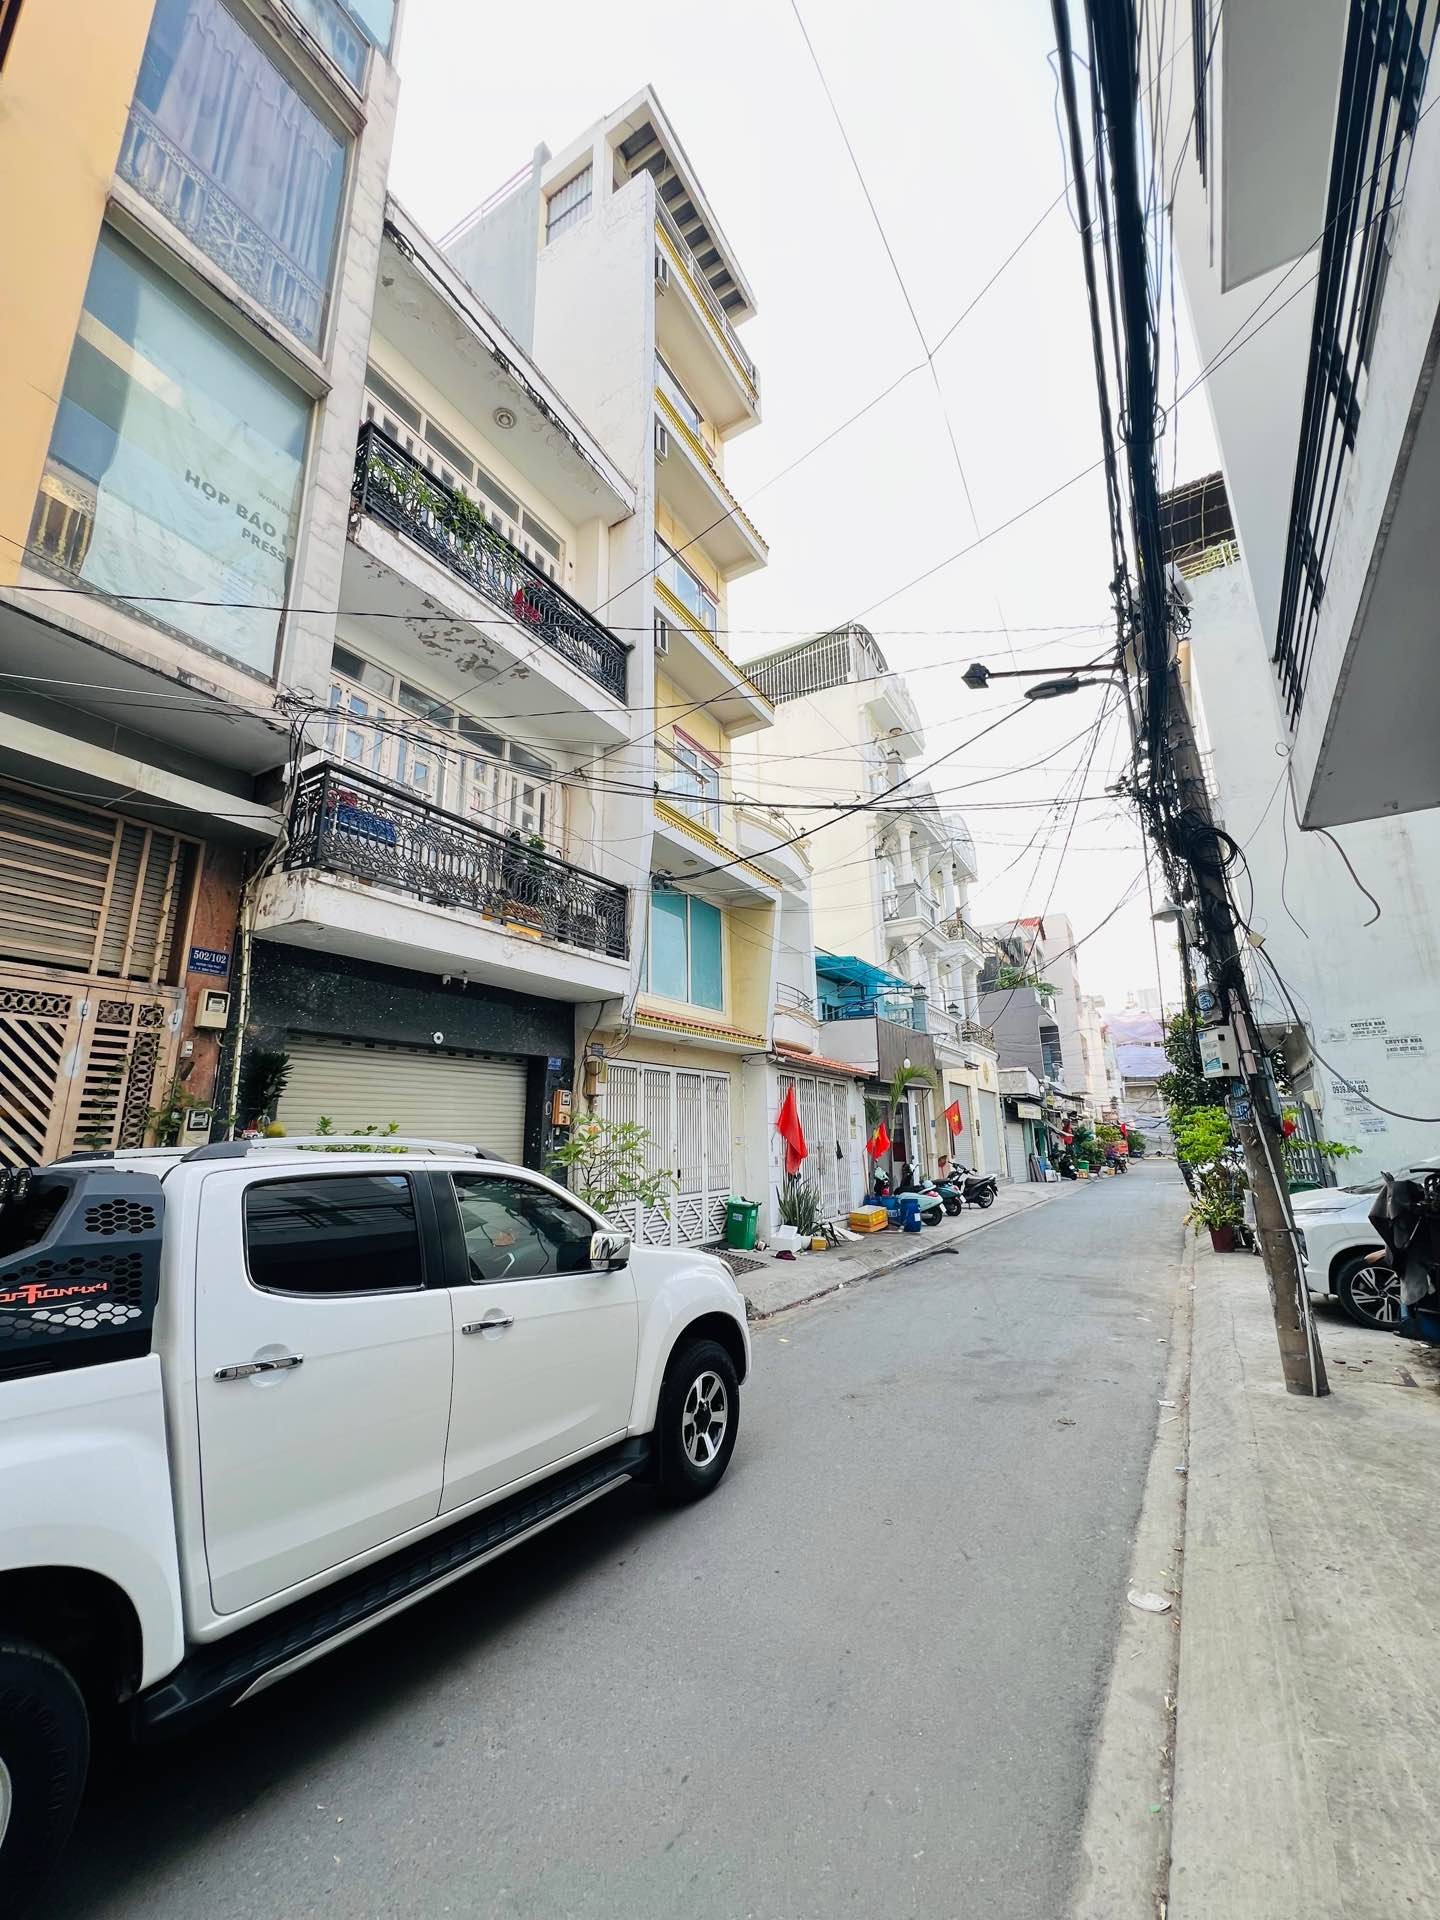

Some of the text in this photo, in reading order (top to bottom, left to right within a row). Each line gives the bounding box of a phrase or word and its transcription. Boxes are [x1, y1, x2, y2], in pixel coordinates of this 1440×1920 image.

[236, 503, 277, 538] BÁO
[241, 527, 285, 563] PRESS
[193, 950, 227, 964] 502/102
